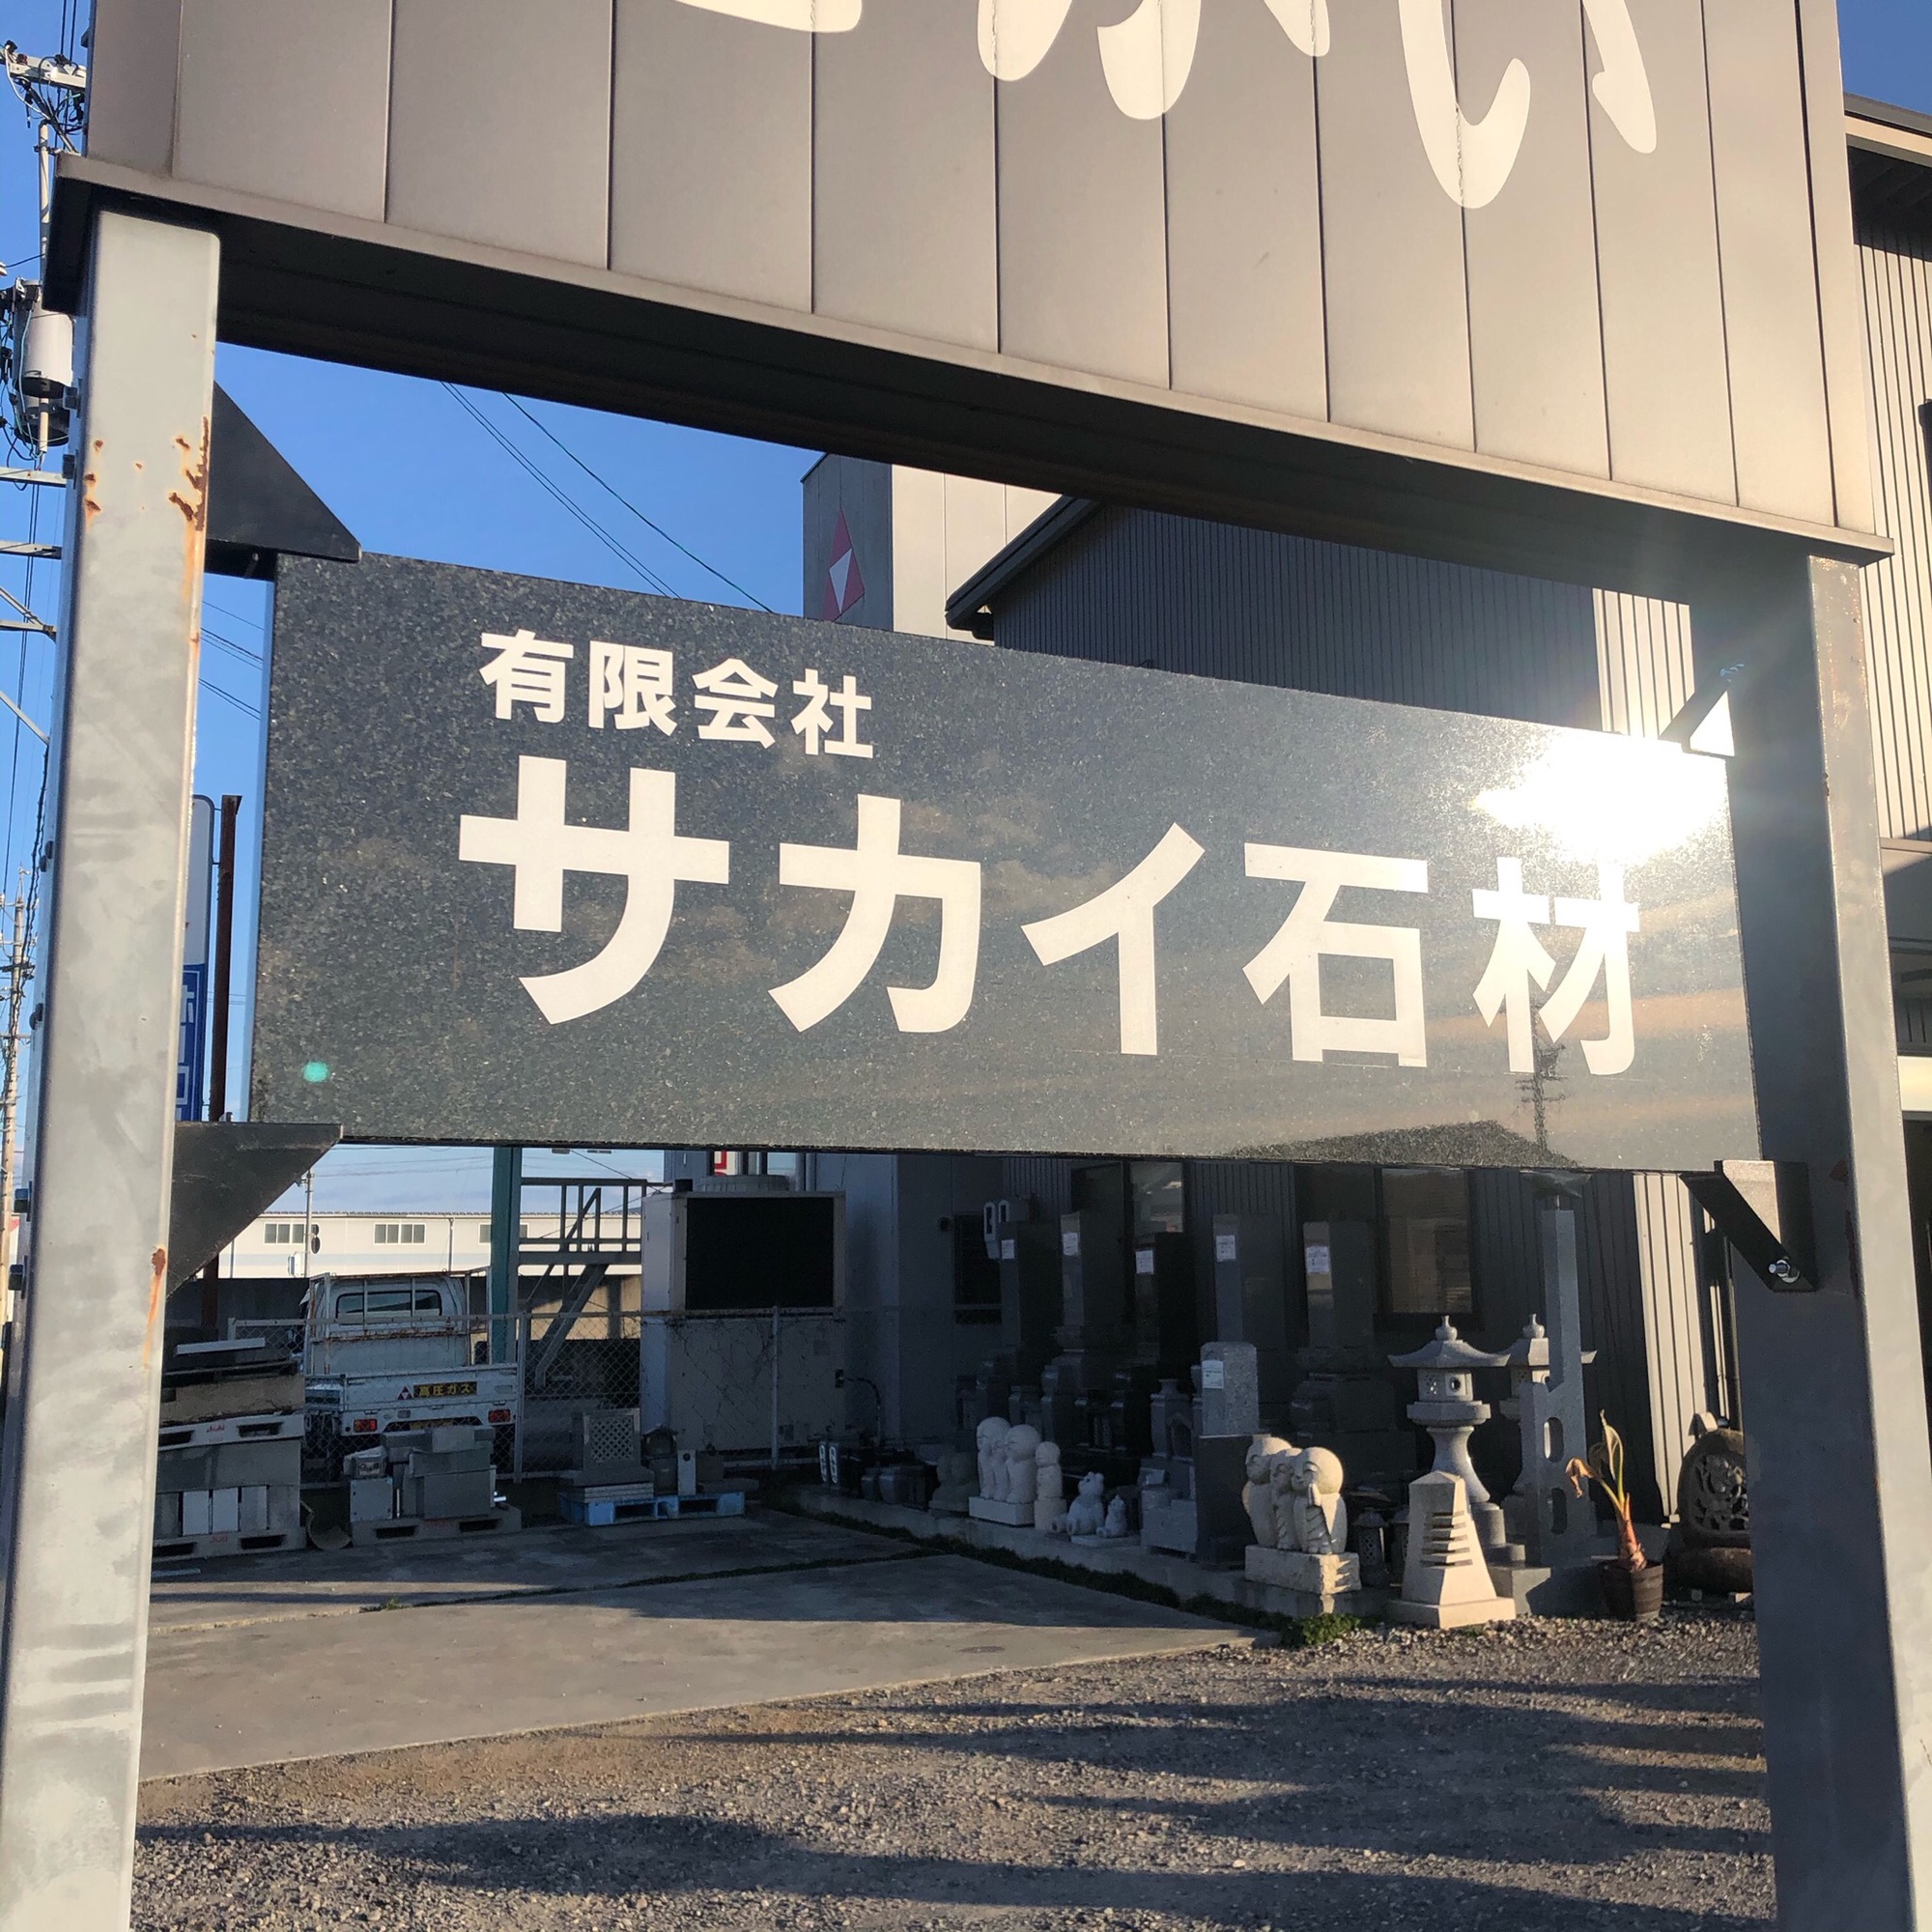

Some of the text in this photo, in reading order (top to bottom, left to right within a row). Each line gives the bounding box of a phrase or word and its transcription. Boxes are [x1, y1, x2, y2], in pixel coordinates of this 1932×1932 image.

[479, 629, 873, 758] 有限会社
[458, 755, 1640, 1076] サカイ石材
[418, 1382, 472, 1398] 高圧ガス
